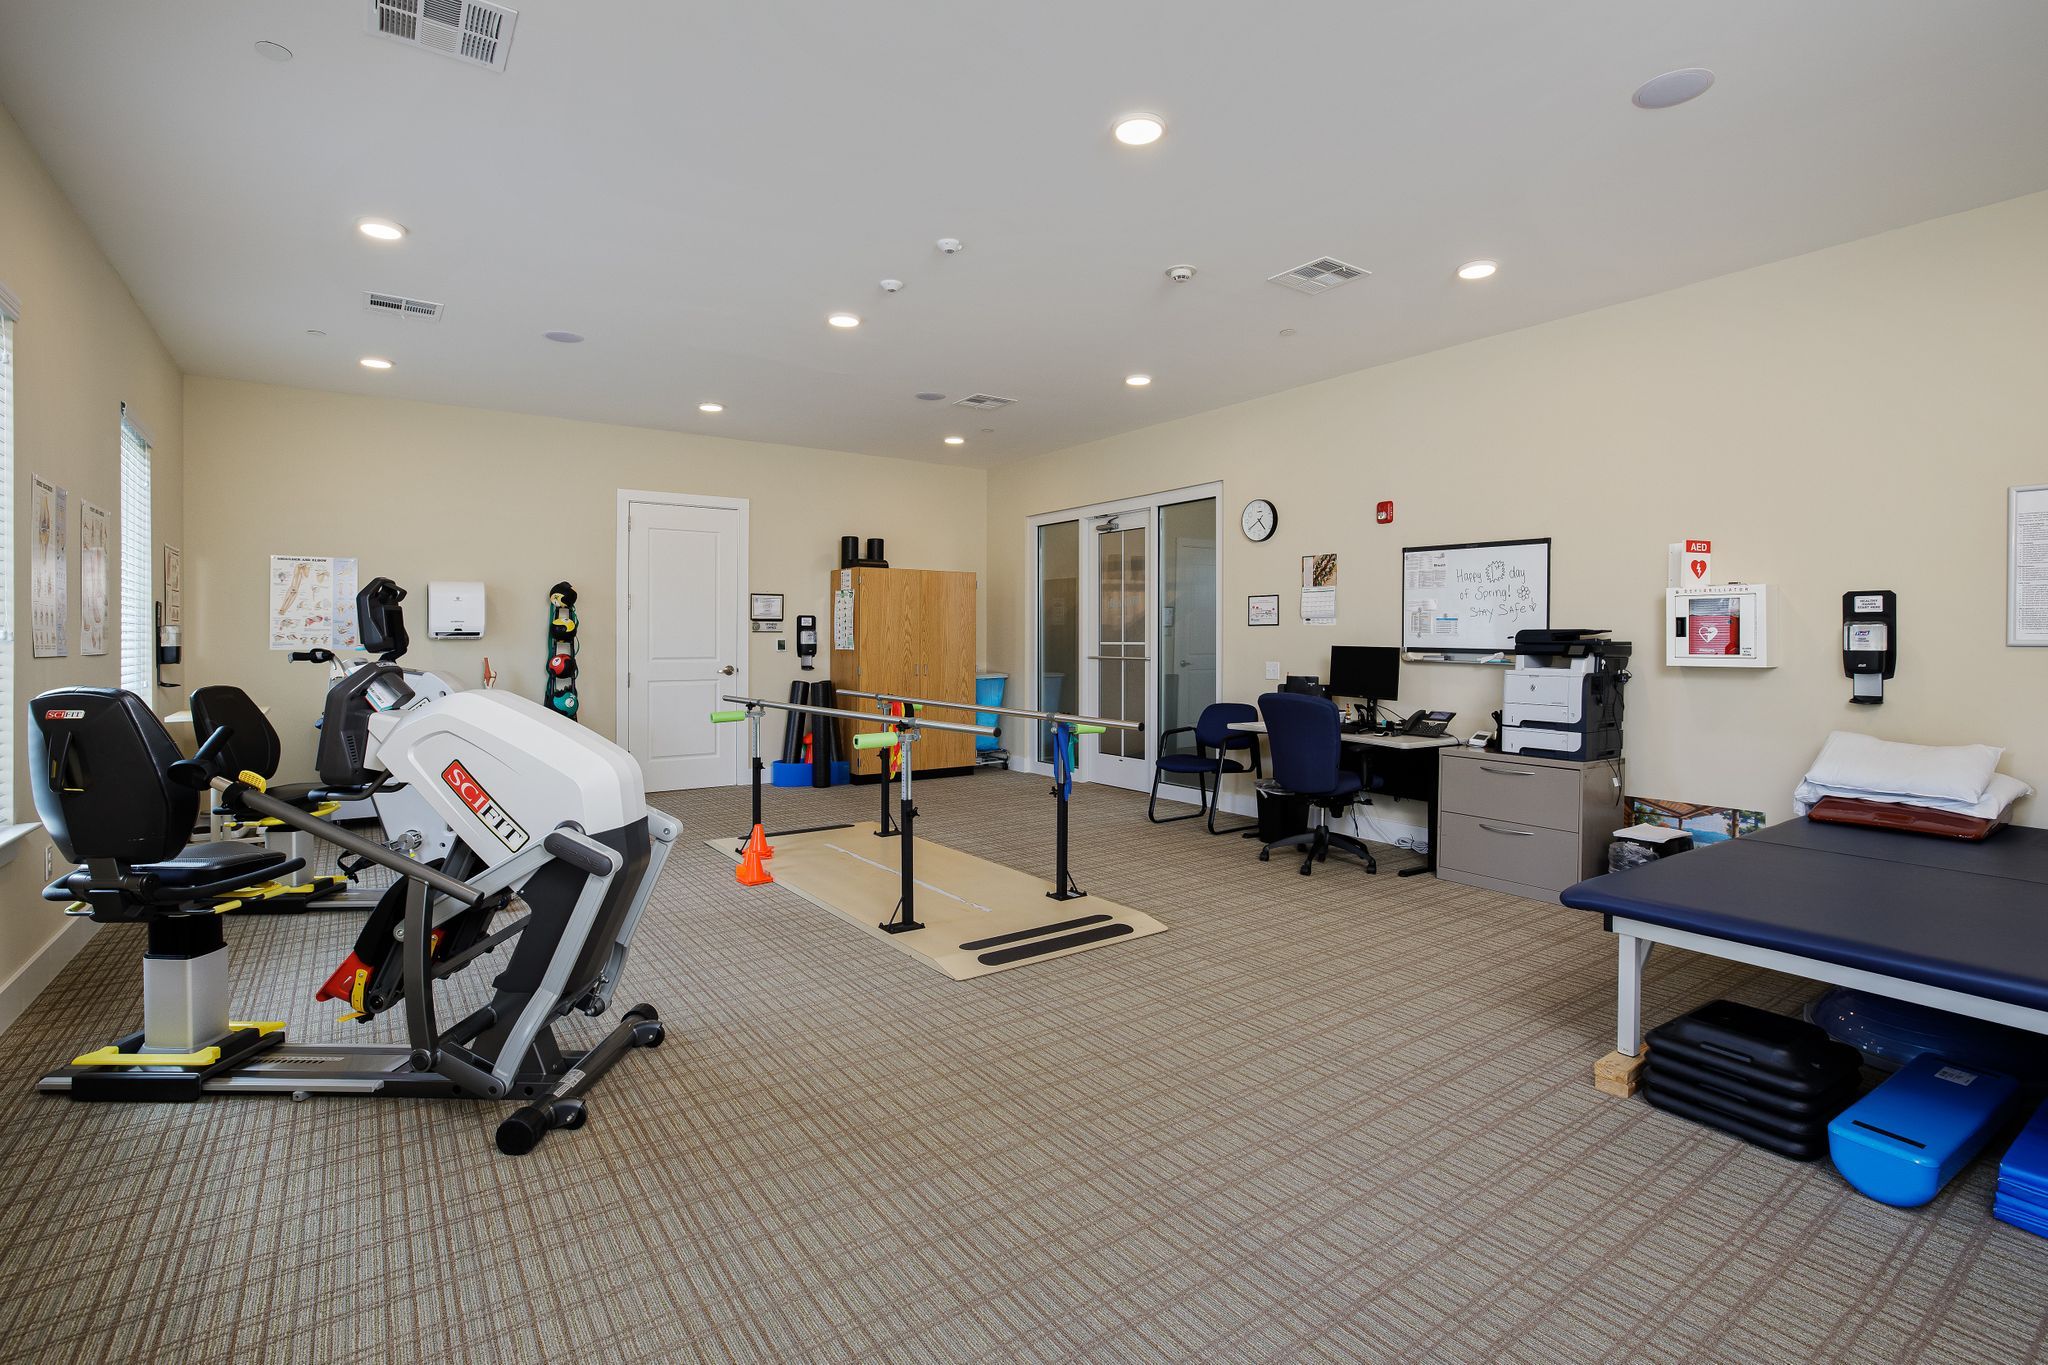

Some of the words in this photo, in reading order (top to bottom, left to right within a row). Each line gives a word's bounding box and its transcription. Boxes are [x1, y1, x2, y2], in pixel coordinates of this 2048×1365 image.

[1691, 543, 1707, 552] AED
[1456, 568, 1483, 583] Happy
[1508, 566, 1526, 584] day
[1459, 588, 1469, 600] of
[1475, 584, 1511, 601] Spring!
[448, 768, 524, 842] SCIFIT
